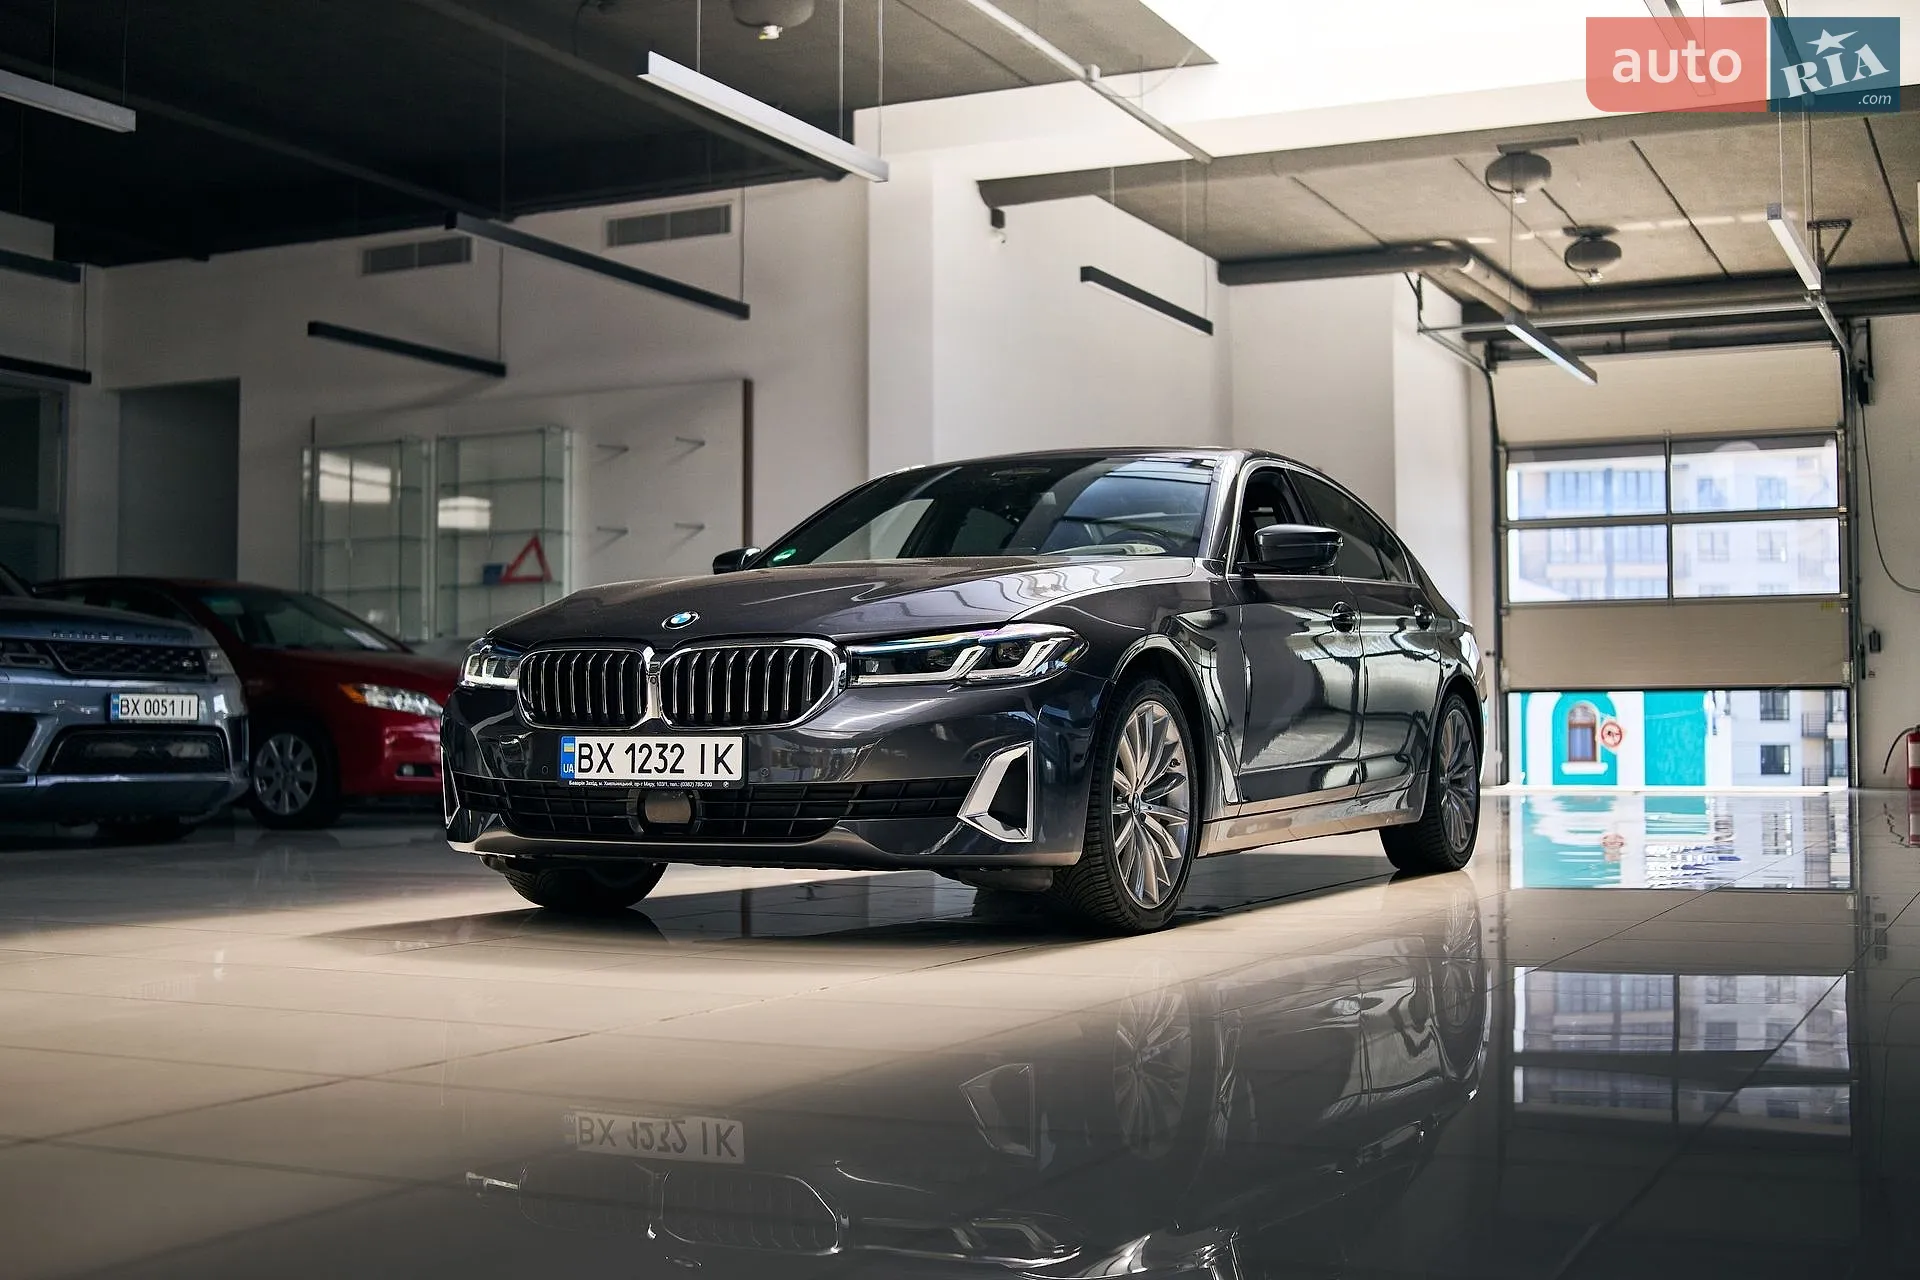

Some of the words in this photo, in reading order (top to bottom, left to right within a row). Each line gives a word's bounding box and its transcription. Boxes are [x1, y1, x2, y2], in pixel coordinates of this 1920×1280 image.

[120, 697, 140, 716] BX
[144, 698, 175, 716] 0051
[577, 742, 615, 774] BX
[624, 742, 685, 774] 1232
[699, 743, 735, 775] IK
[563, 763, 574, 774] UA
